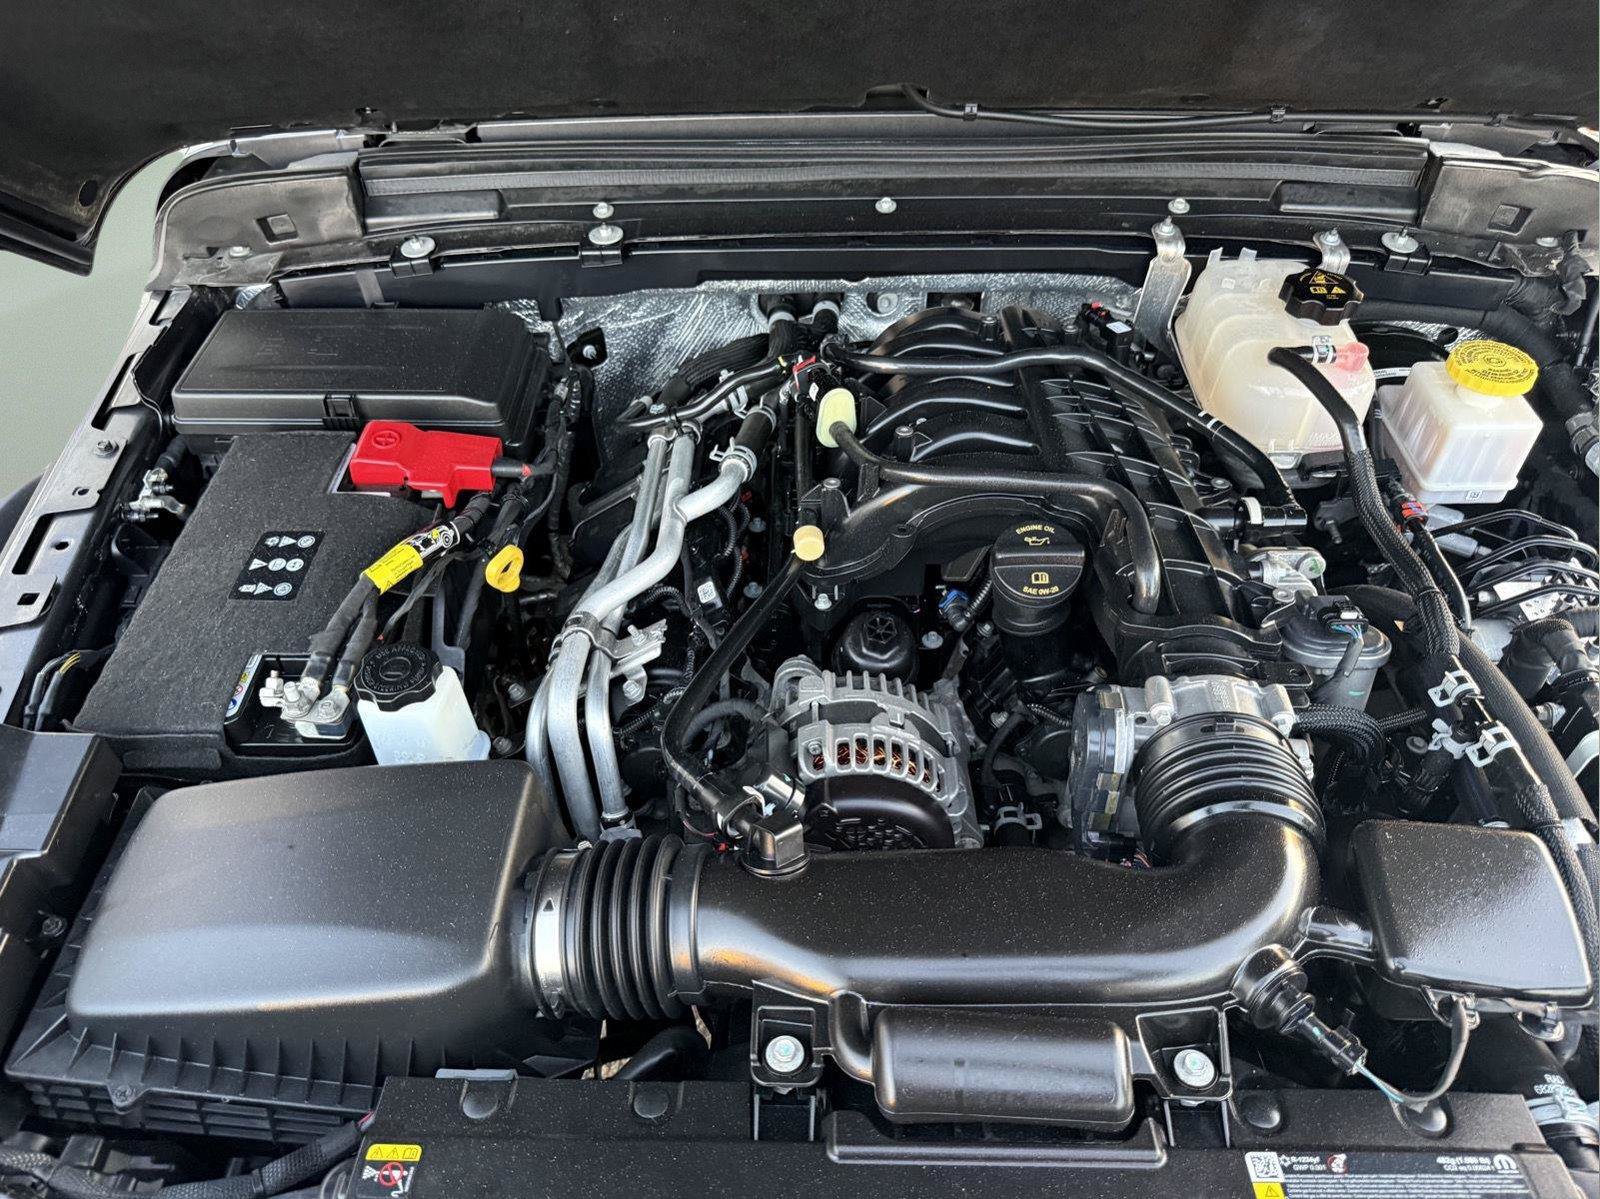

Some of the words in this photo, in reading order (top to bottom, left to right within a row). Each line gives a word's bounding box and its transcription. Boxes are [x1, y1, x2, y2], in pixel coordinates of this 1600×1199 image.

[1015, 524, 1043, 534] ENGINE
[1043, 525, 1055, 534] OIL
[1022, 585, 1038, 595] SAE
[1038, 585, 1059, 595] 0W-20
[1543, 1073, 1565, 1085] RAD
